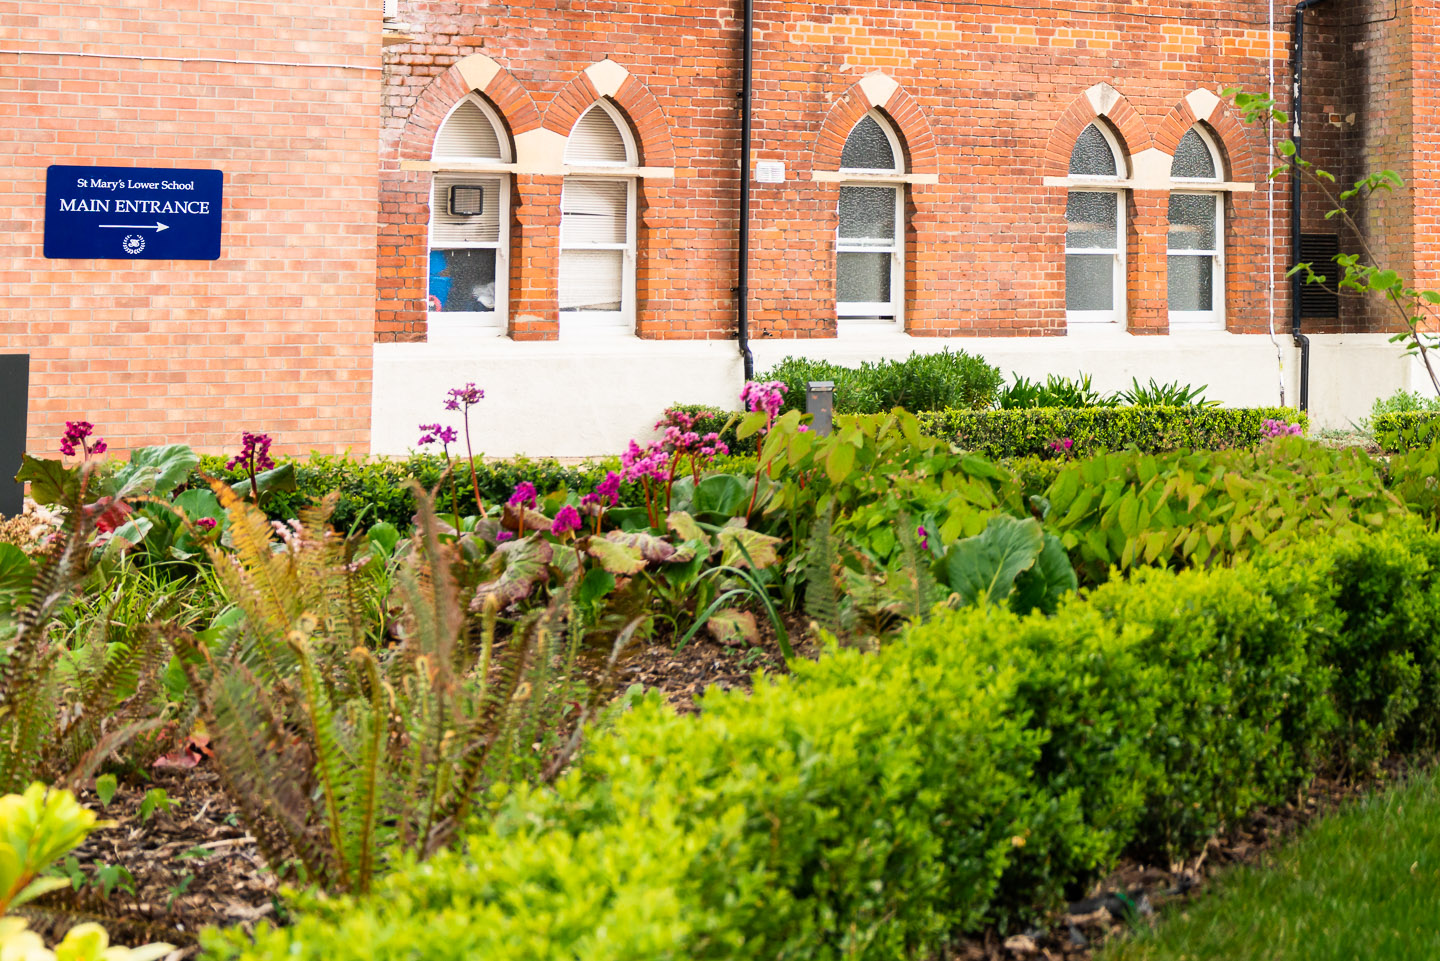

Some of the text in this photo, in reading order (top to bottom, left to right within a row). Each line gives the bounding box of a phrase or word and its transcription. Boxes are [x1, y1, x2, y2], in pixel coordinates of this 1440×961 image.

[77, 178, 194, 191] St Mary's Lower School
[59, 198, 209, 214] MAIN ENTRANCE
